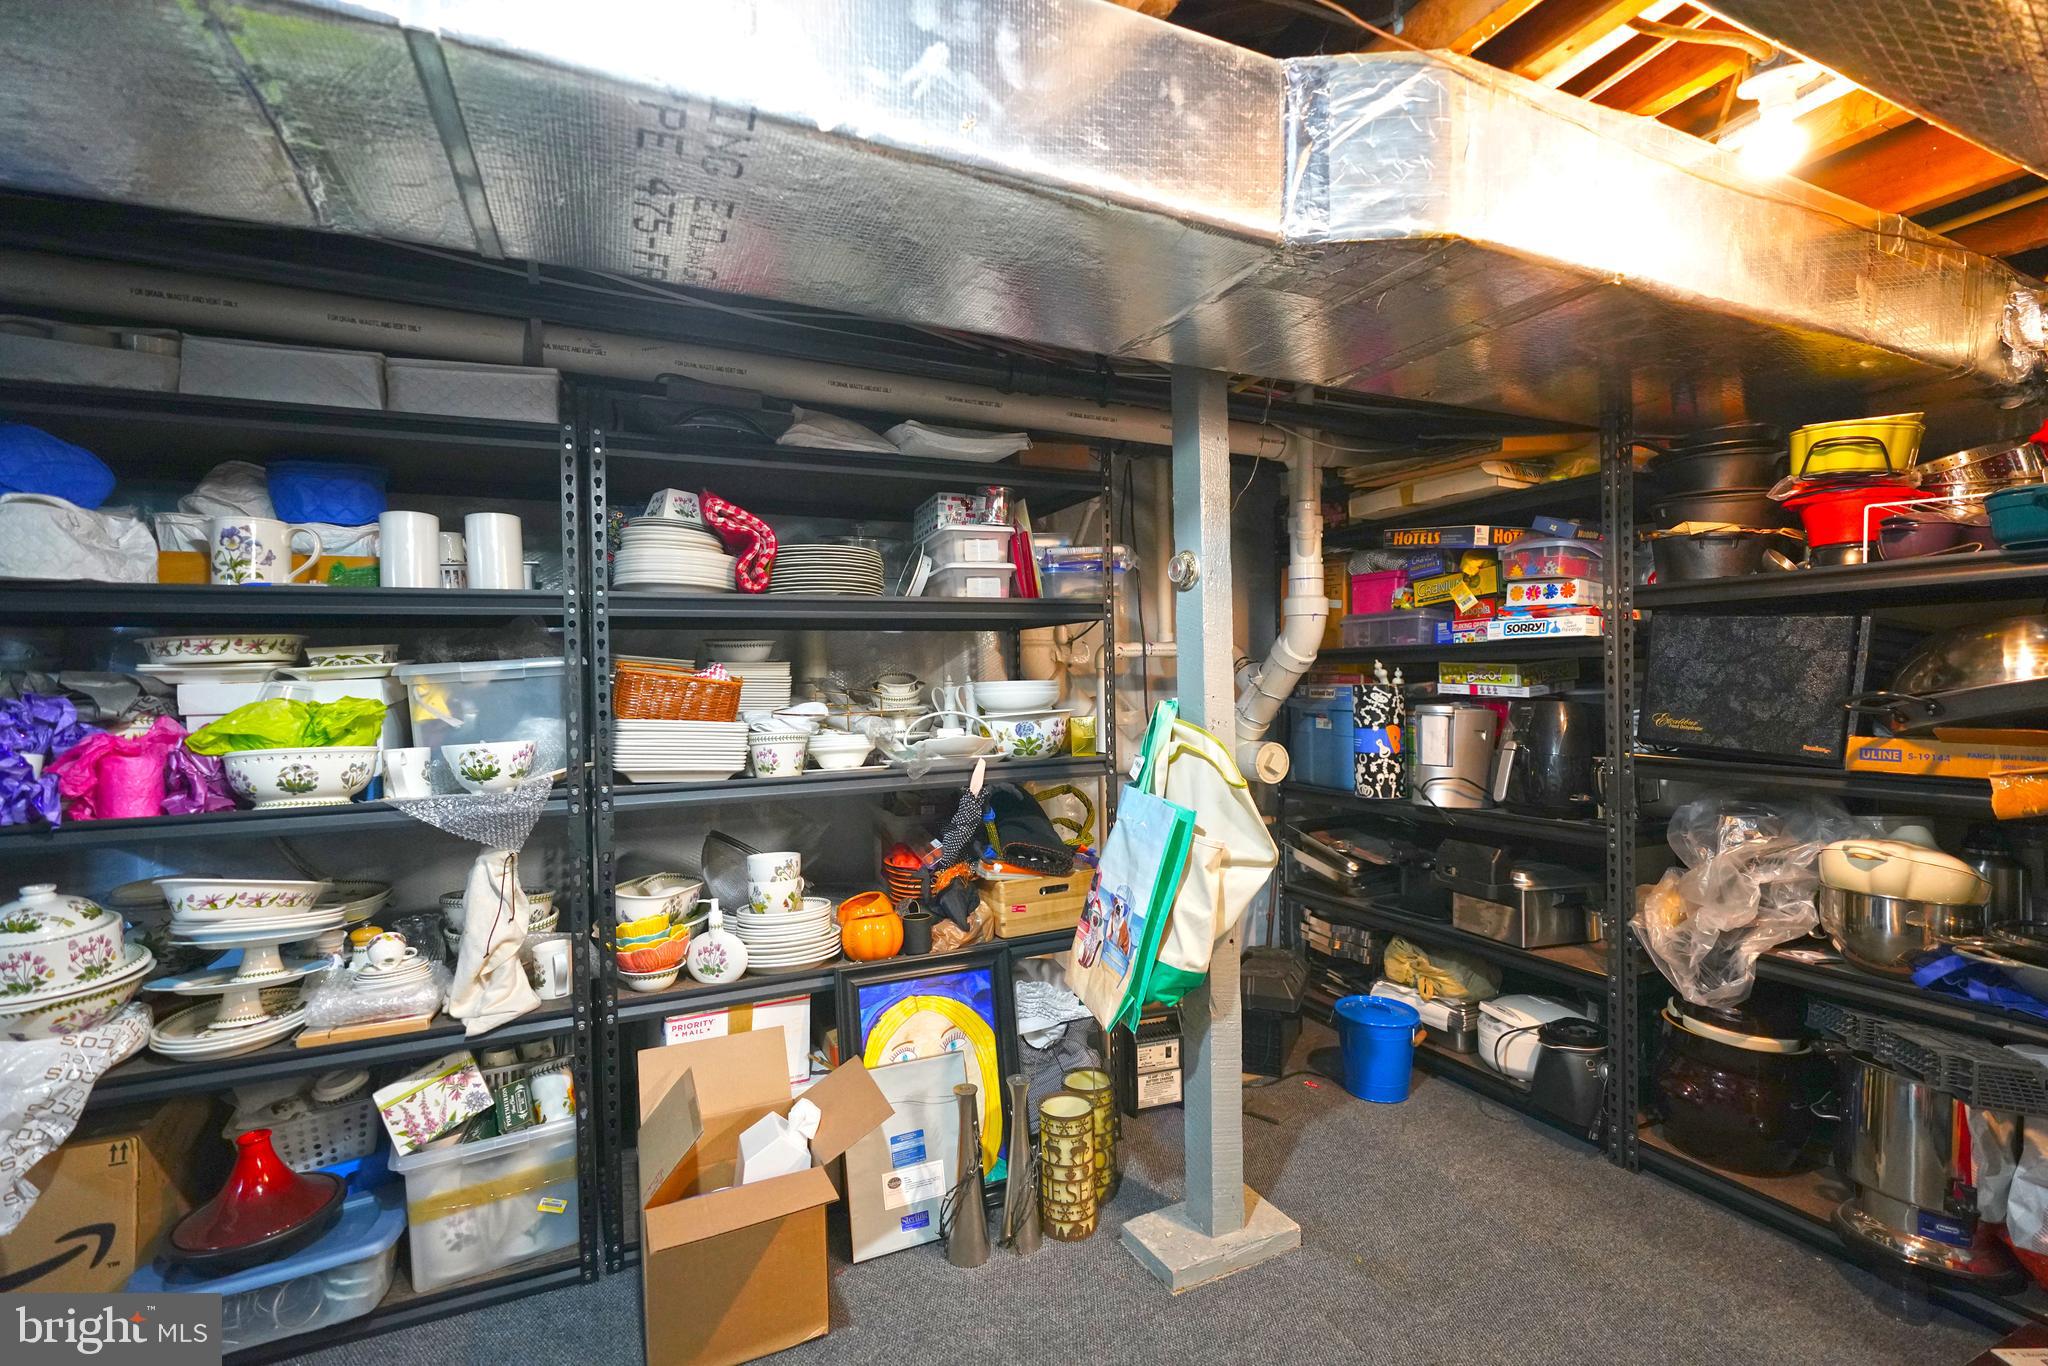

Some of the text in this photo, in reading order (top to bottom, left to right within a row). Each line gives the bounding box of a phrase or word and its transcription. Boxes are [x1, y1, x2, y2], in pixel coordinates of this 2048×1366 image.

[1393, 531, 1441, 546] HOTELS
[1506, 622, 1546, 634] SORRY!
[1862, 750, 1900, 761] ULINE
[671, 1018, 715, 1032] PRIORITY
[682, 1029, 704, 1037] MAIL
[501, 1086, 512, 1128] PORTMEIRION
